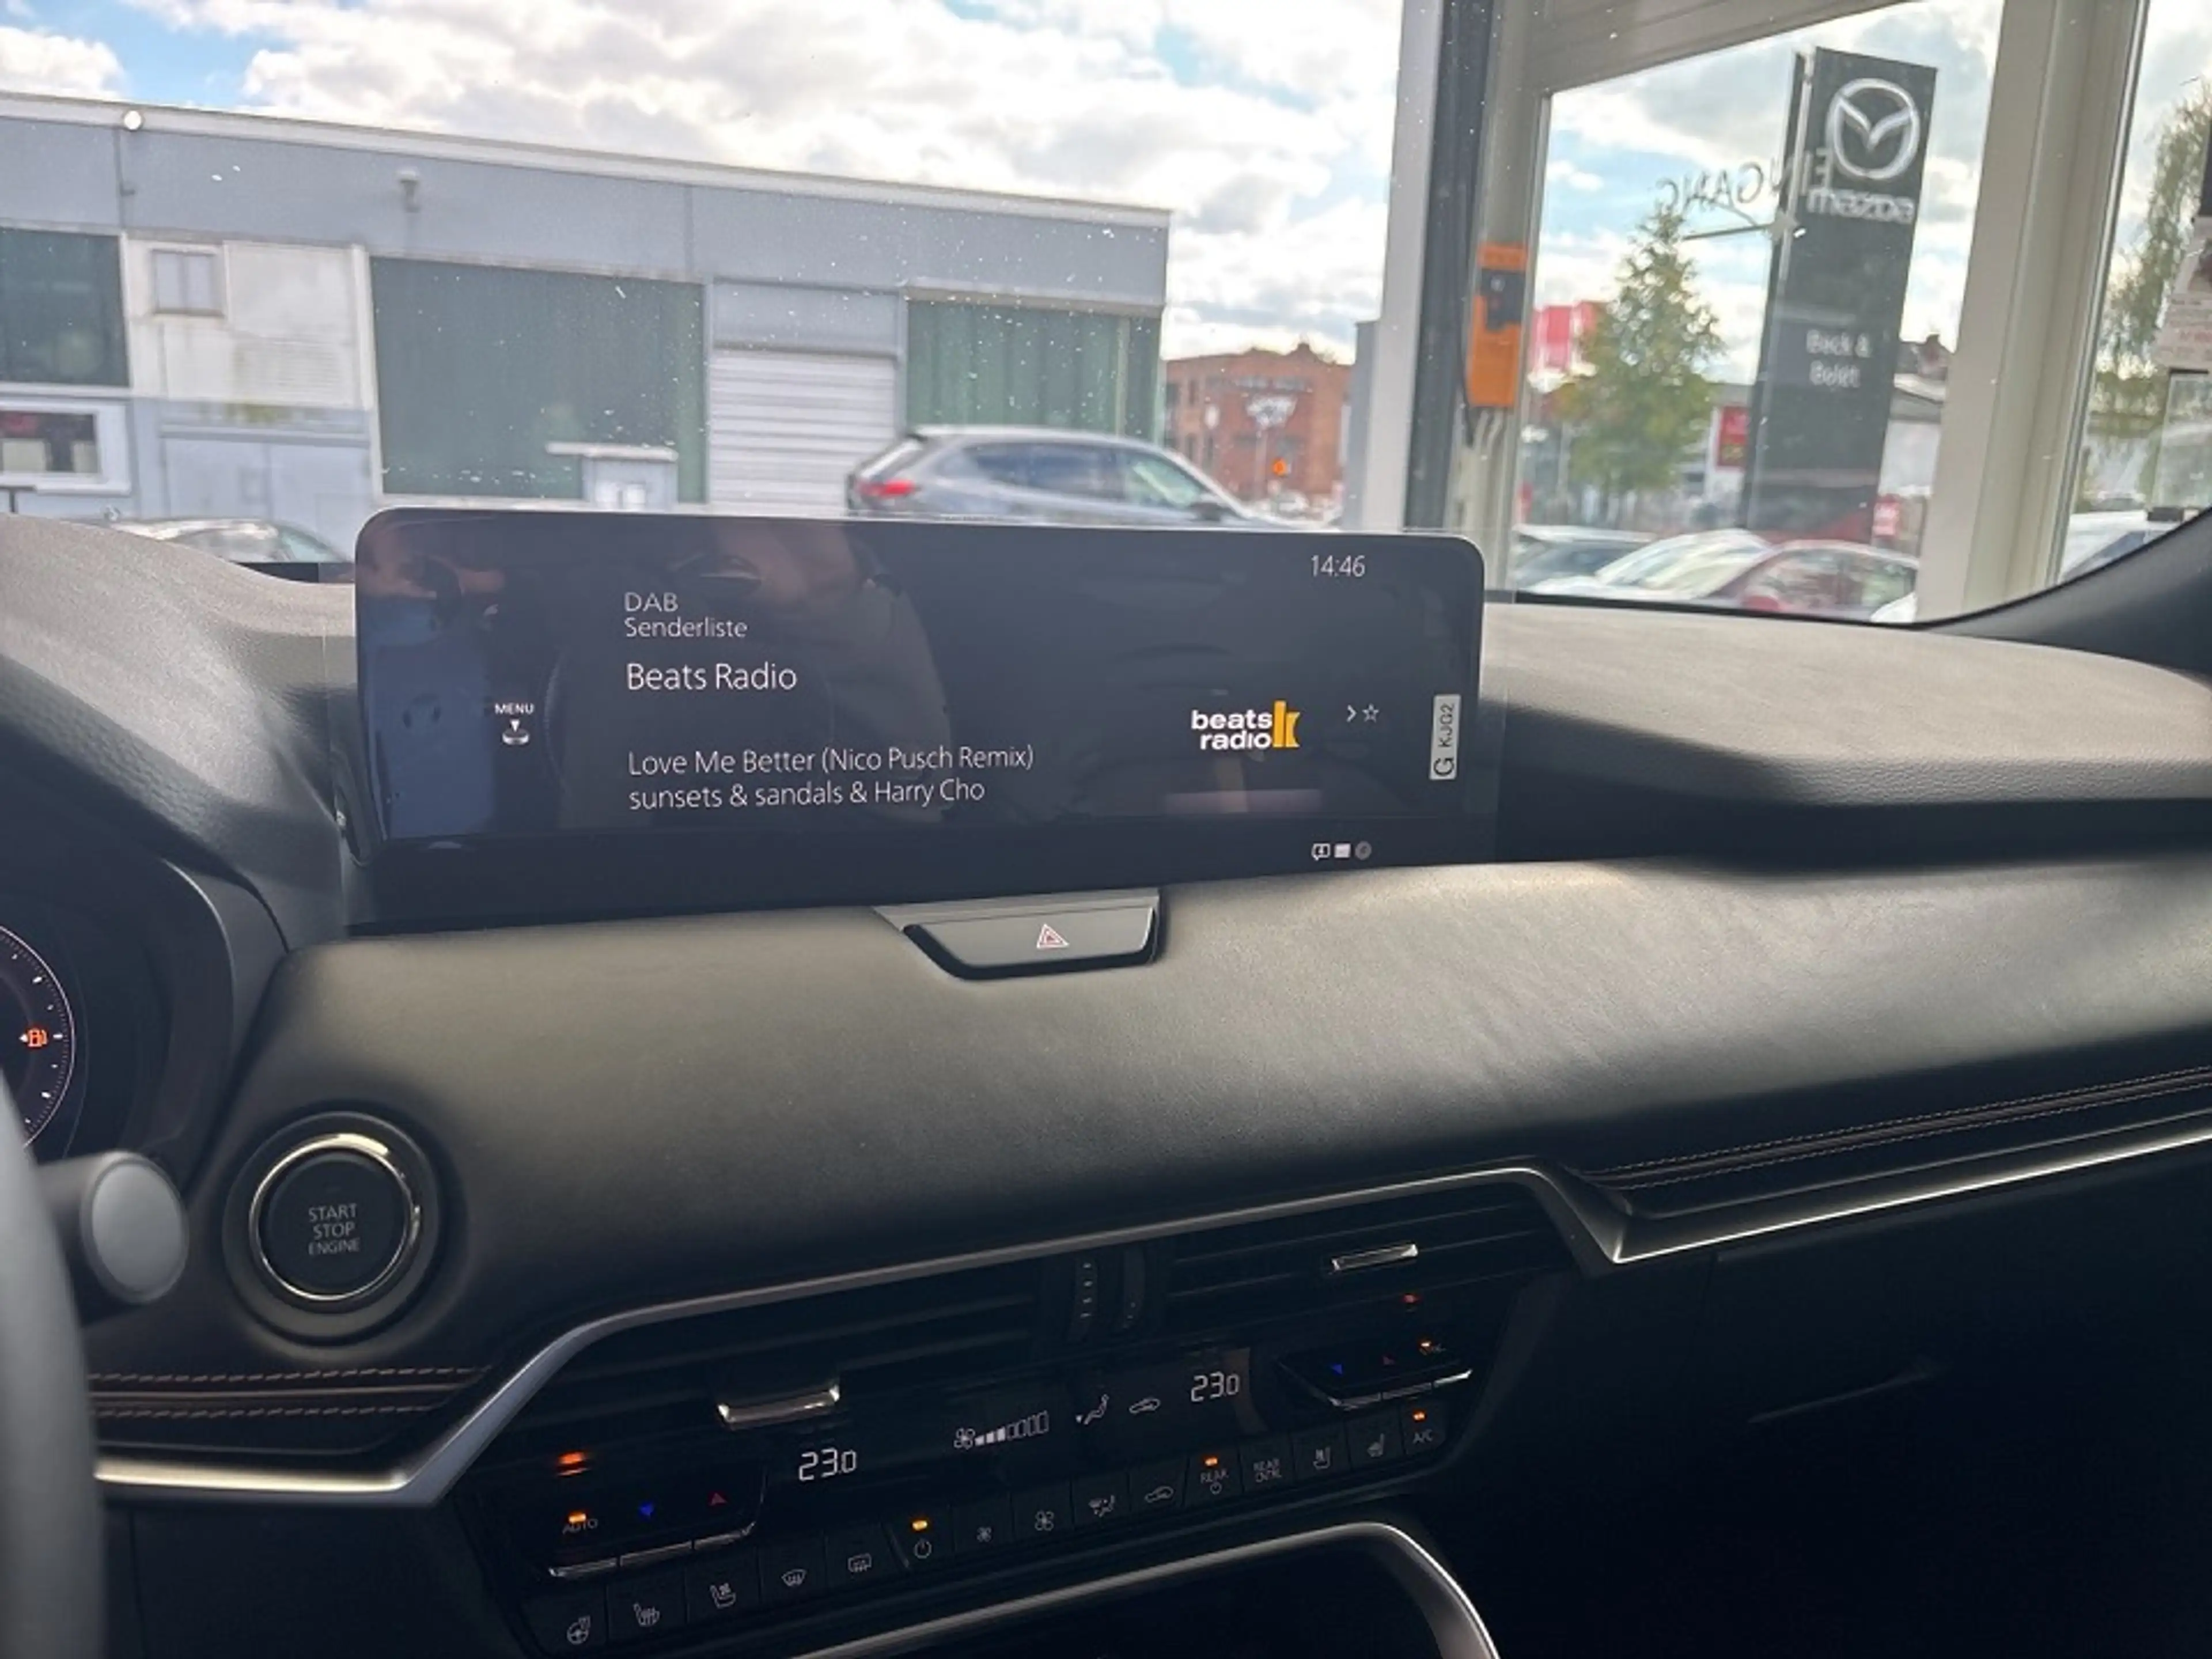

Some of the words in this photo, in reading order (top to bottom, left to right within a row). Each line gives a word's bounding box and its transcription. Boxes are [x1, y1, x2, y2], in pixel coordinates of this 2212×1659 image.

[1311, 555, 1365, 577] 14:46
[624, 592, 679, 612] DAB
[624, 616, 748, 638] Senderliste
[627, 662, 708, 691] Beats
[715, 661, 798, 691] Radio
[495, 702, 535, 714] MENU
[1191, 709, 1272, 730] beats
[1438, 703, 1455, 747] KJG2
[1200, 730, 1272, 750] radio
[628, 751, 688, 775] Love
[695, 750, 736, 774] Me
[743, 748, 816, 774] Better
[821, 747, 882, 774] (Nico
[889, 744, 953, 770] Pusch
[958, 744, 1034, 771] Remix)
[1433, 757, 1455, 777] G
[628, 787, 723, 810] sunsets
[729, 783, 748, 807] &
[755, 780, 844, 806] sandals
[850, 781, 868, 804] &
[874, 781, 935, 808] Harry
[940, 777, 986, 801] Cho
[308, 1203, 357, 1222] START
[313, 1221, 355, 1240] STOP
[308, 1237, 361, 1255] ENGINE
[1191, 1372, 1240, 1402] 23.0
[798, 1448, 857, 1481] 23.0
